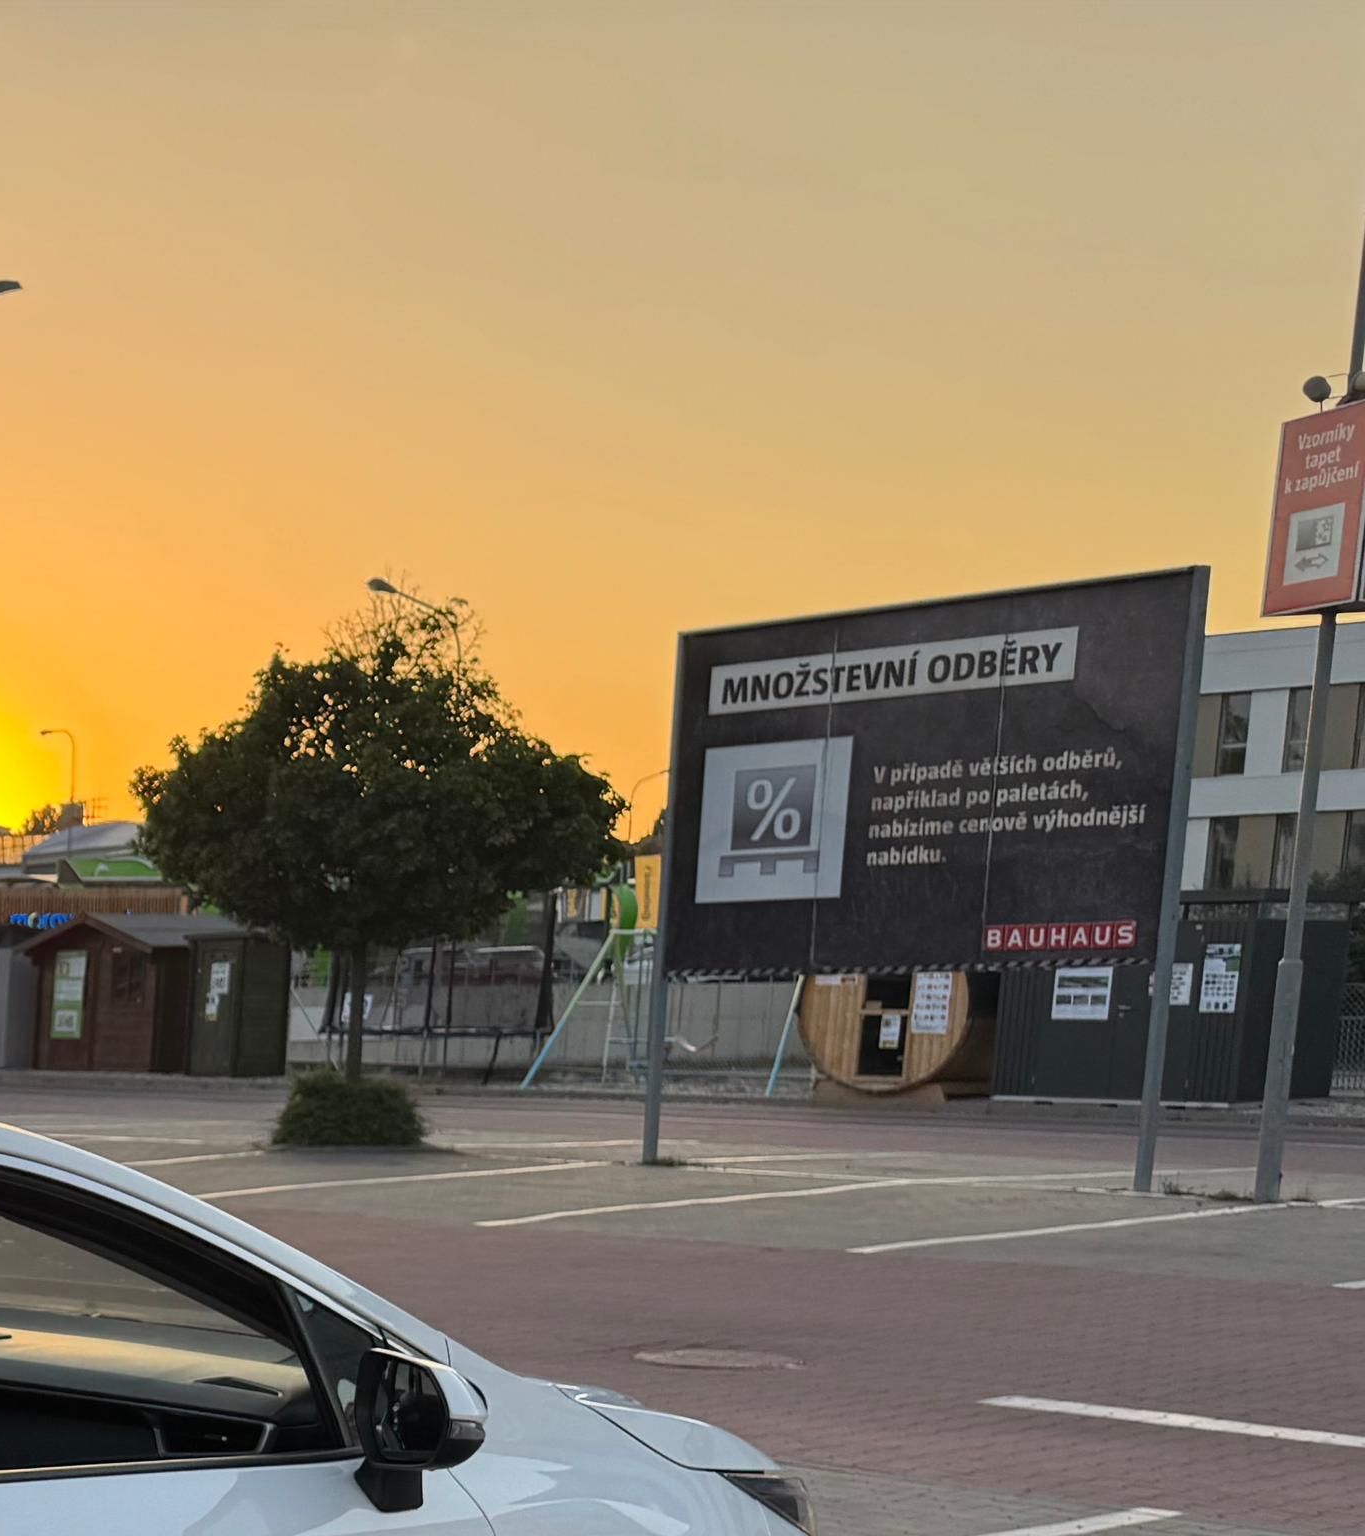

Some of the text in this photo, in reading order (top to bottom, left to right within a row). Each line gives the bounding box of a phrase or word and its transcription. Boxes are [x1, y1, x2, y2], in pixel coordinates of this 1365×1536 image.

[1298, 423, 1355, 450] Vzorníky
[1305, 445, 1342, 469] tapet
[1285, 461, 1360, 494] k zapůjčení
[721, 640, 1063, 705] MNOŽSTEVNÍ ODBĚRY
[873, 746, 1123, 786] V případě větších odběrů,
[871, 779, 1089, 813] například po paletách,
[868, 804, 1147, 839] nabízíme cenově výhodnější
[866, 846, 946, 866] nabídku.
[986, 924, 1135, 949] BAUHAUS
